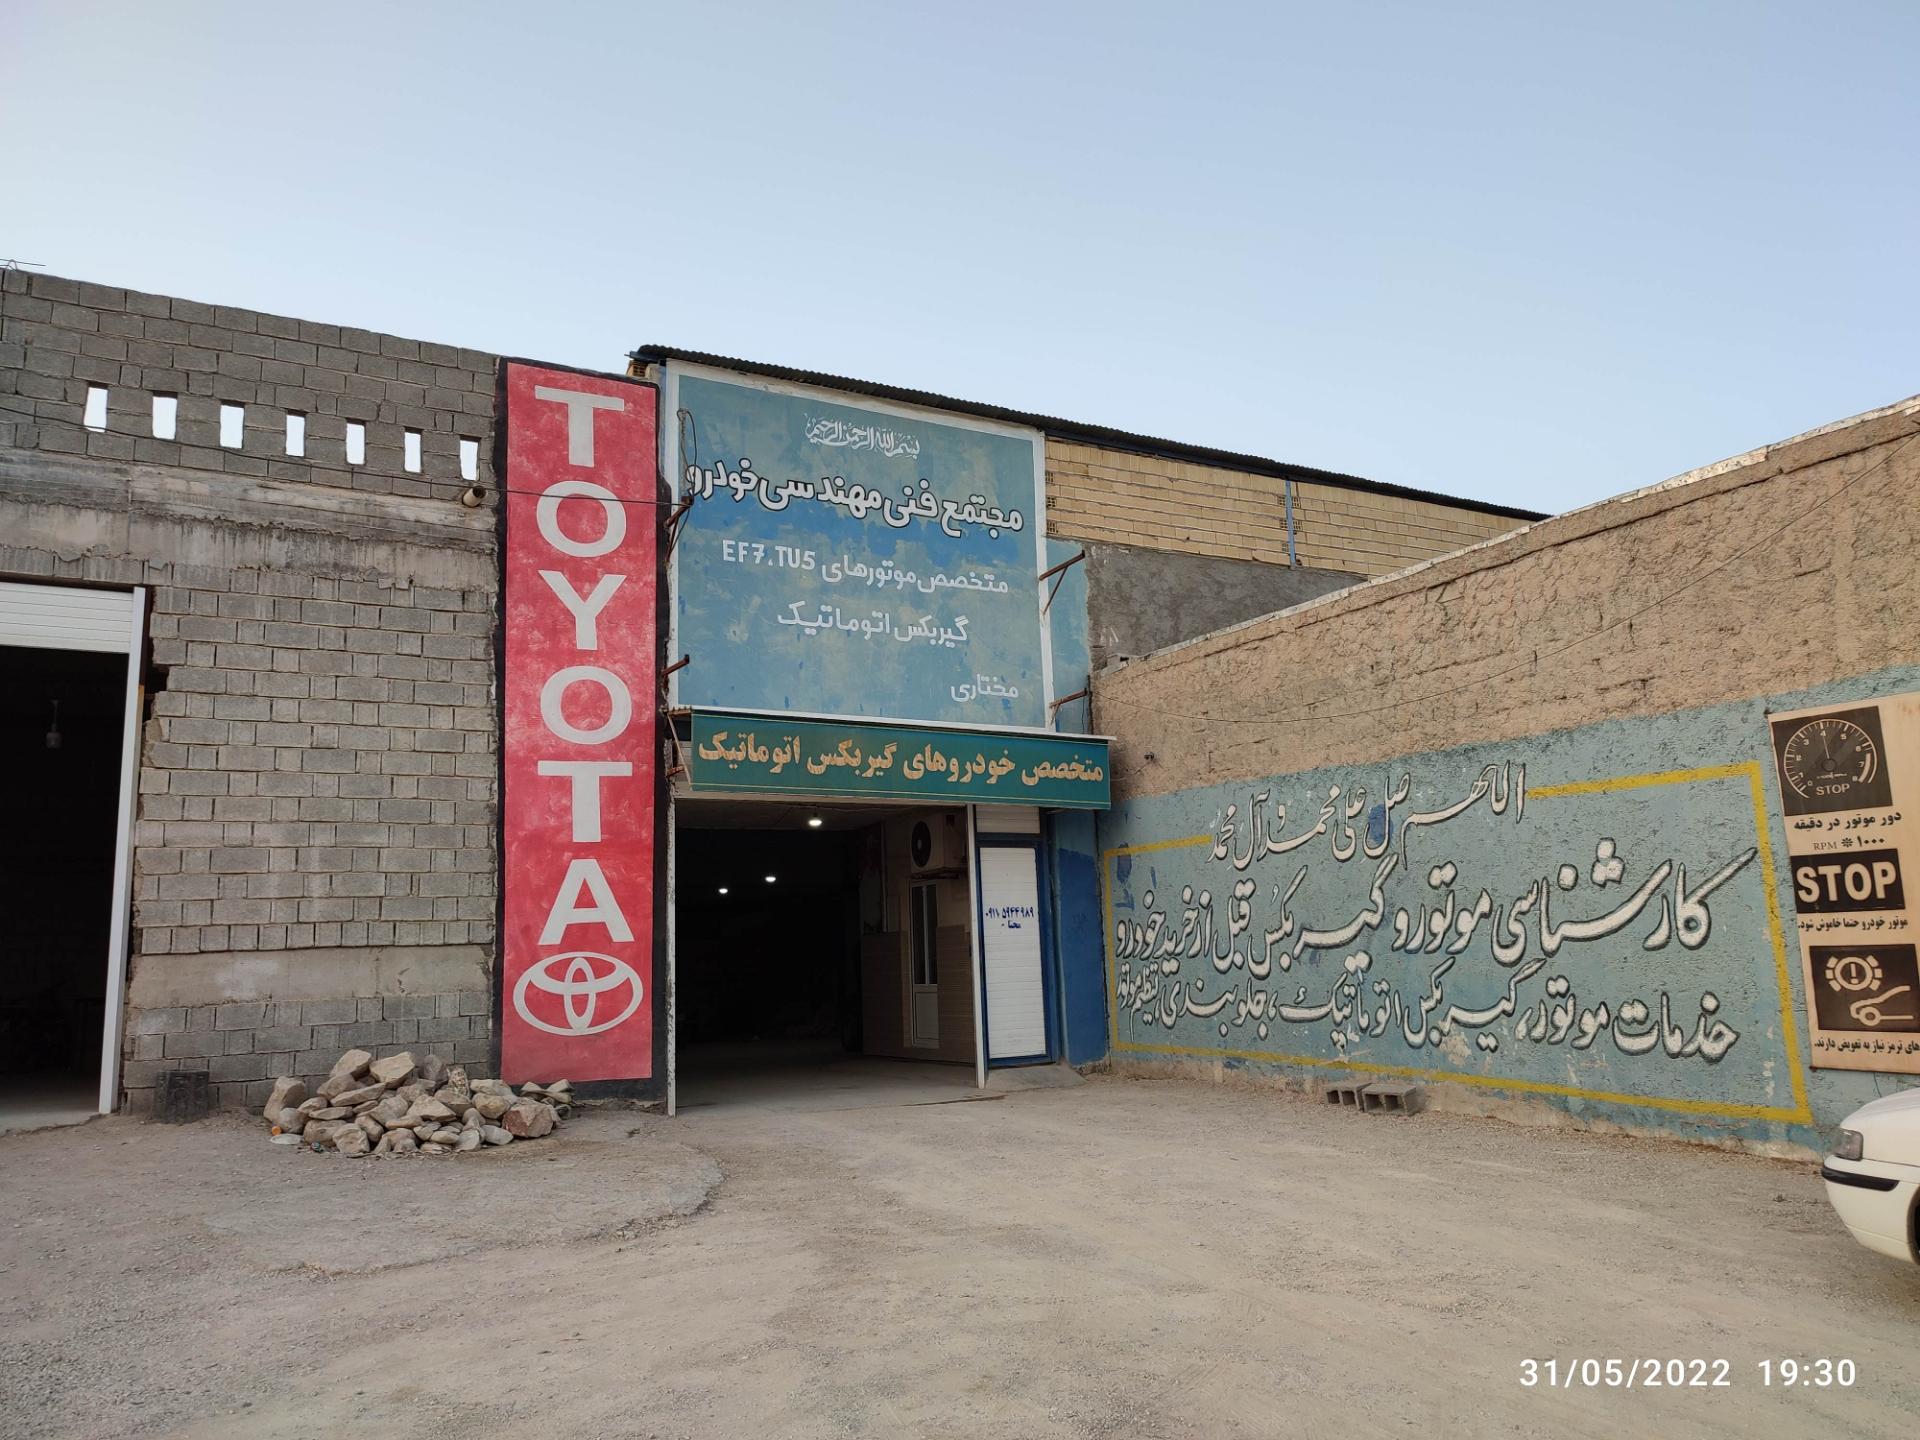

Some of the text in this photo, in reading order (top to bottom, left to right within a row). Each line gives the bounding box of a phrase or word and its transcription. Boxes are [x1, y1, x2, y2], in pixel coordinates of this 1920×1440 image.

[684, 456, 1025, 540] مجتمع فنی مهندسی خودرو
[821, 554, 917, 591] موتورهای
[917, 571, 1009, 595] متخصص
[776, 600, 970, 650] گیربکس اتوماتیک
[534, 385, 635, 946] TOYOTA
[949, 673, 1020, 703] مختاری
[697, 731, 1106, 786] متخصص خودروهای گیربکس اتوماتیک
[1816, 783, 1850, 796] STOP
[1794, 812, 1902, 832] دور موتور در دقیقه
[1813, 841, 1838, 851] RPM
[1405, 860, 1492, 955] موتور
[1490, 837, 1758, 967] کارشناسی
[1796, 861, 1897, 903] STOP
[1116, 889, 1166, 961] خودرو
[1152, 884, 1200, 977] خرید
[1187, 889, 1213, 958] از
[1212, 878, 1256, 974] قبل
[1247, 853, 1398, 980] گیربکس
[1816, 918, 1841, 932] خاموش
[1862, 917, 1885, 931] خودرو
[1888, 916, 1908, 930] موتور
[1402, 956, 1547, 1053] گیربکس
[1612, 990, 1740, 1064] خدمات
[1872, 1039, 1885, 1053] نیاز
